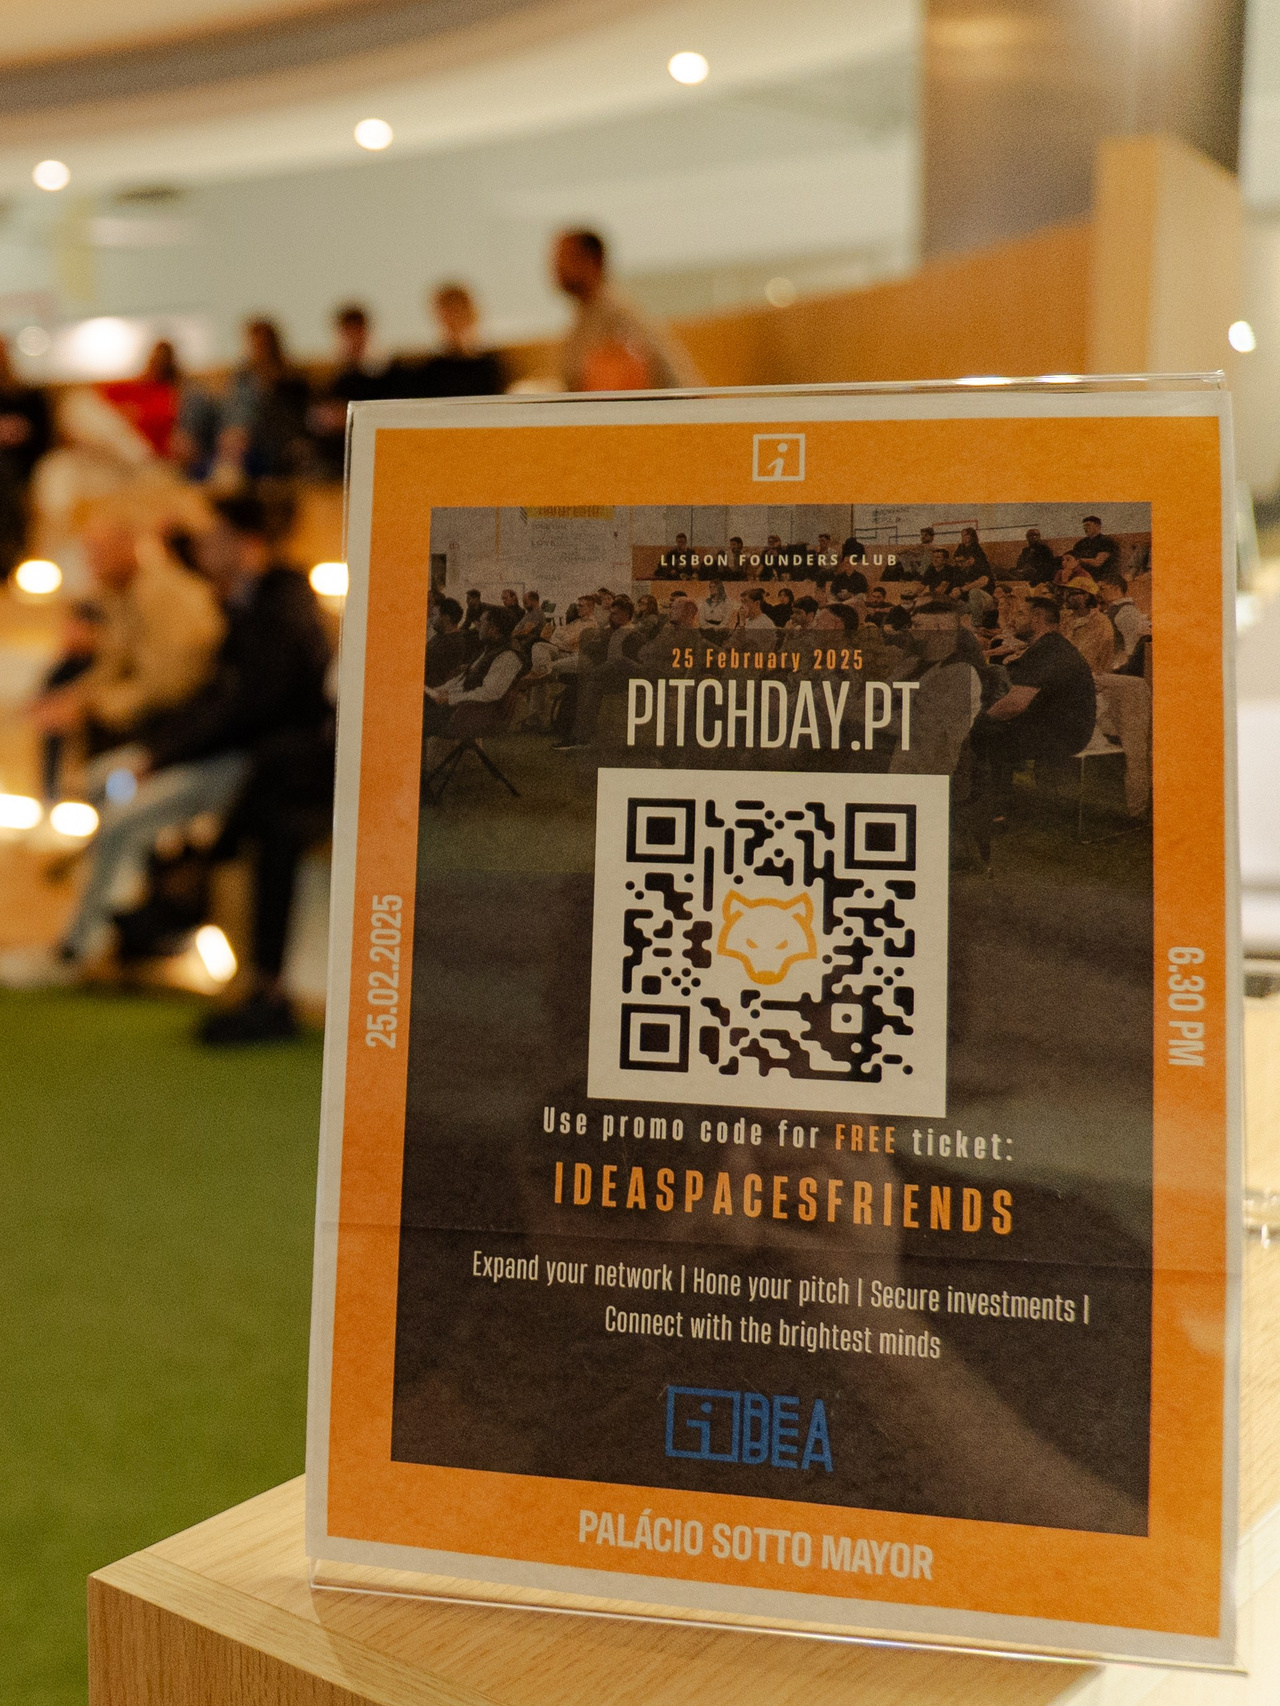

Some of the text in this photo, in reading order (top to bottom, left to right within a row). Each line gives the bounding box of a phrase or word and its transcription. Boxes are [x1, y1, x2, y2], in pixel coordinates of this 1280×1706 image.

[660, 554, 898, 566] LISBON FOUNDERS CLUB
[672, 648, 864, 672] 25 February 2025
[627, 678, 920, 751] PITCHDAY.PT
[365, 894, 403, 1049] 25.02.2025
[1168, 946, 1206, 1067] 6.30 PM
[543, 1106, 1013, 1161] Use promo code for FREE ticket:
[554, 1161, 1013, 1235] IDEASPACESFRIENDS
[472, 1250, 539, 1283] Expand
[546, 1260, 588, 1286] your
[595, 1262, 673, 1292] network
[693, 1267, 741, 1297] Hone
[748, 1275, 792, 1302] your
[799, 1275, 849, 1307] pitch
[871, 1279, 940, 1313] Secure
[947, 1285, 1076, 1323] investments
[605, 1305, 941, 1359] Connect with the brightest minds
[578, 1509, 934, 1580] PALÁCIO SOTTO MAYOR
